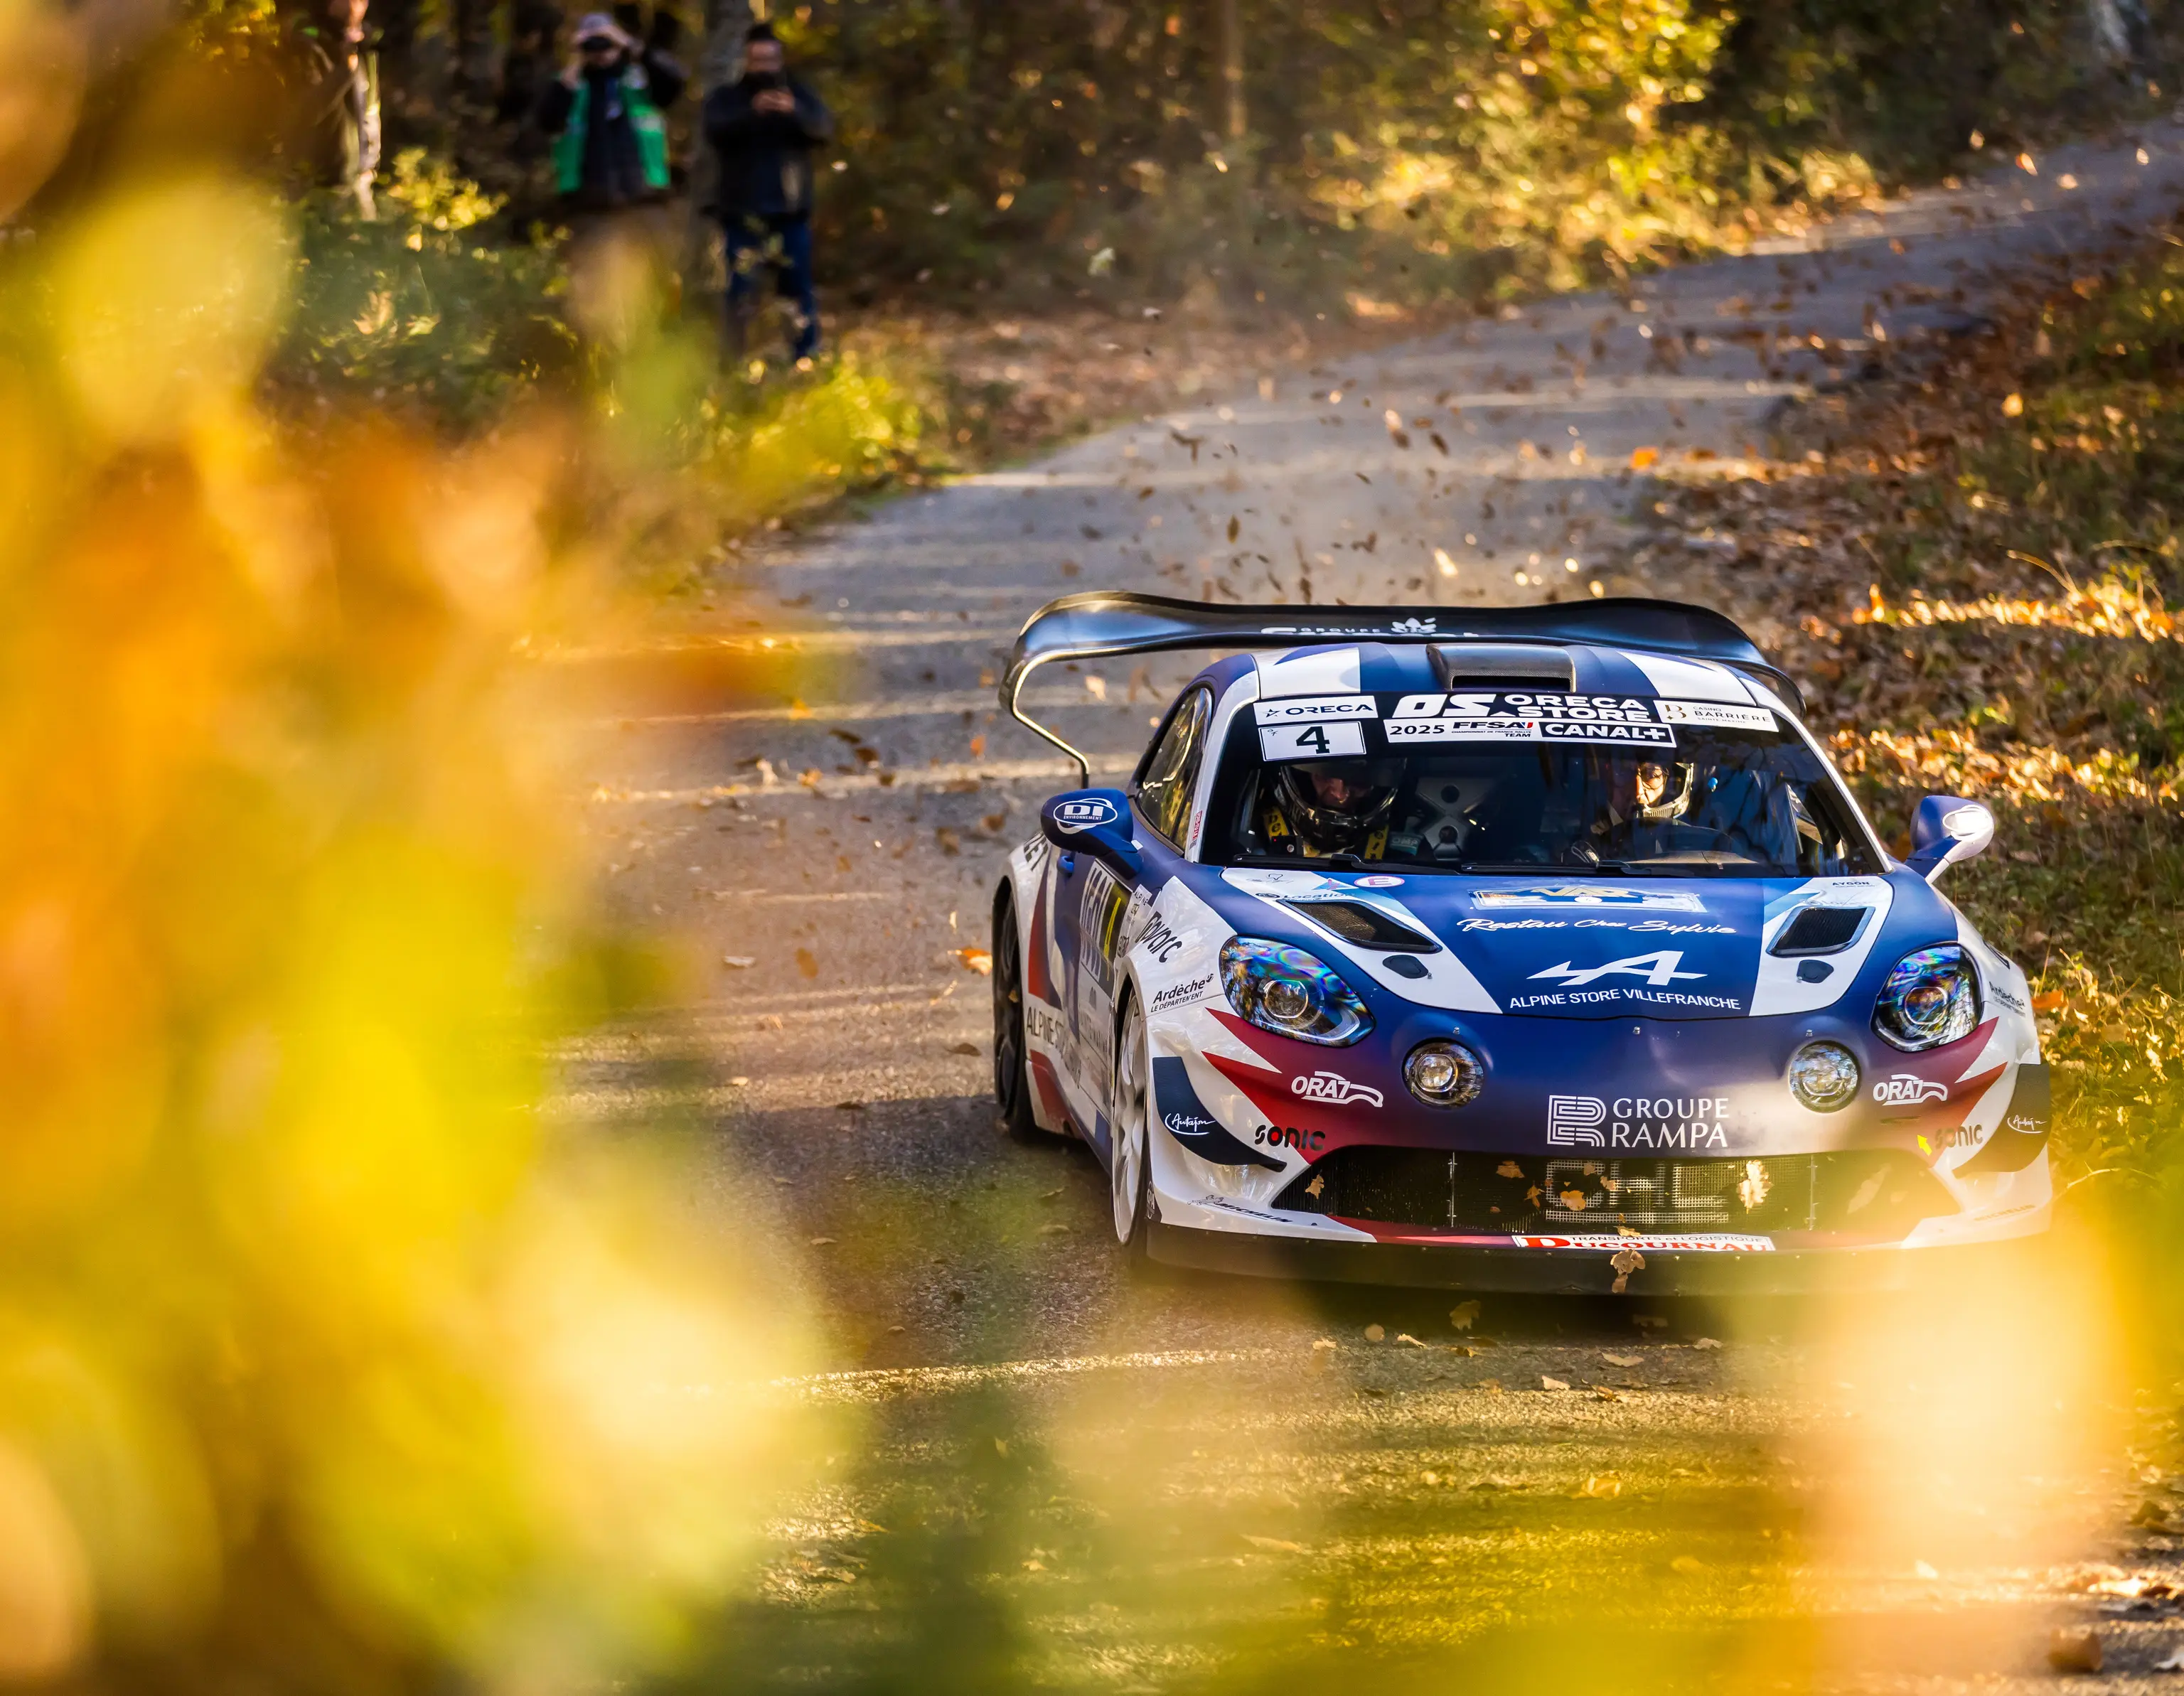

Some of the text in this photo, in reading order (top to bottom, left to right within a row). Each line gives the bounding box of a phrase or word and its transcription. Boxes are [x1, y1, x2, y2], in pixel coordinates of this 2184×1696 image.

[1285, 704, 1374, 715] ORECA
[1504, 694, 1647, 711] ORECA
[1517, 706, 1652, 722] STORE
[1694, 711, 1770, 722] BARRIÈRE
[1390, 724, 1445, 735] 2025
[1545, 723, 1666, 740] CANAL+
[1295, 726, 1330, 754] 4
[1064, 805, 1104, 817] DI
[1152, 979, 1206, 1004] Ardèche
[1509, 988, 1741, 1010] ALPINE STORE VILLEFRANCHE
[1150, 1004, 1158, 1013] LE
[1291, 1075, 1351, 1100] ORA7
[1873, 1079, 1923, 1101] ORA7
[1612, 1097, 1729, 1119] GROUPE
[1171, 1112, 1216, 1132] Autajon
[1611, 1121, 1728, 1149] RAMPA
[1215, 1202, 1293, 1223] MICHELIN
[1521, 1237, 1768, 1251] DUCOURNAU
